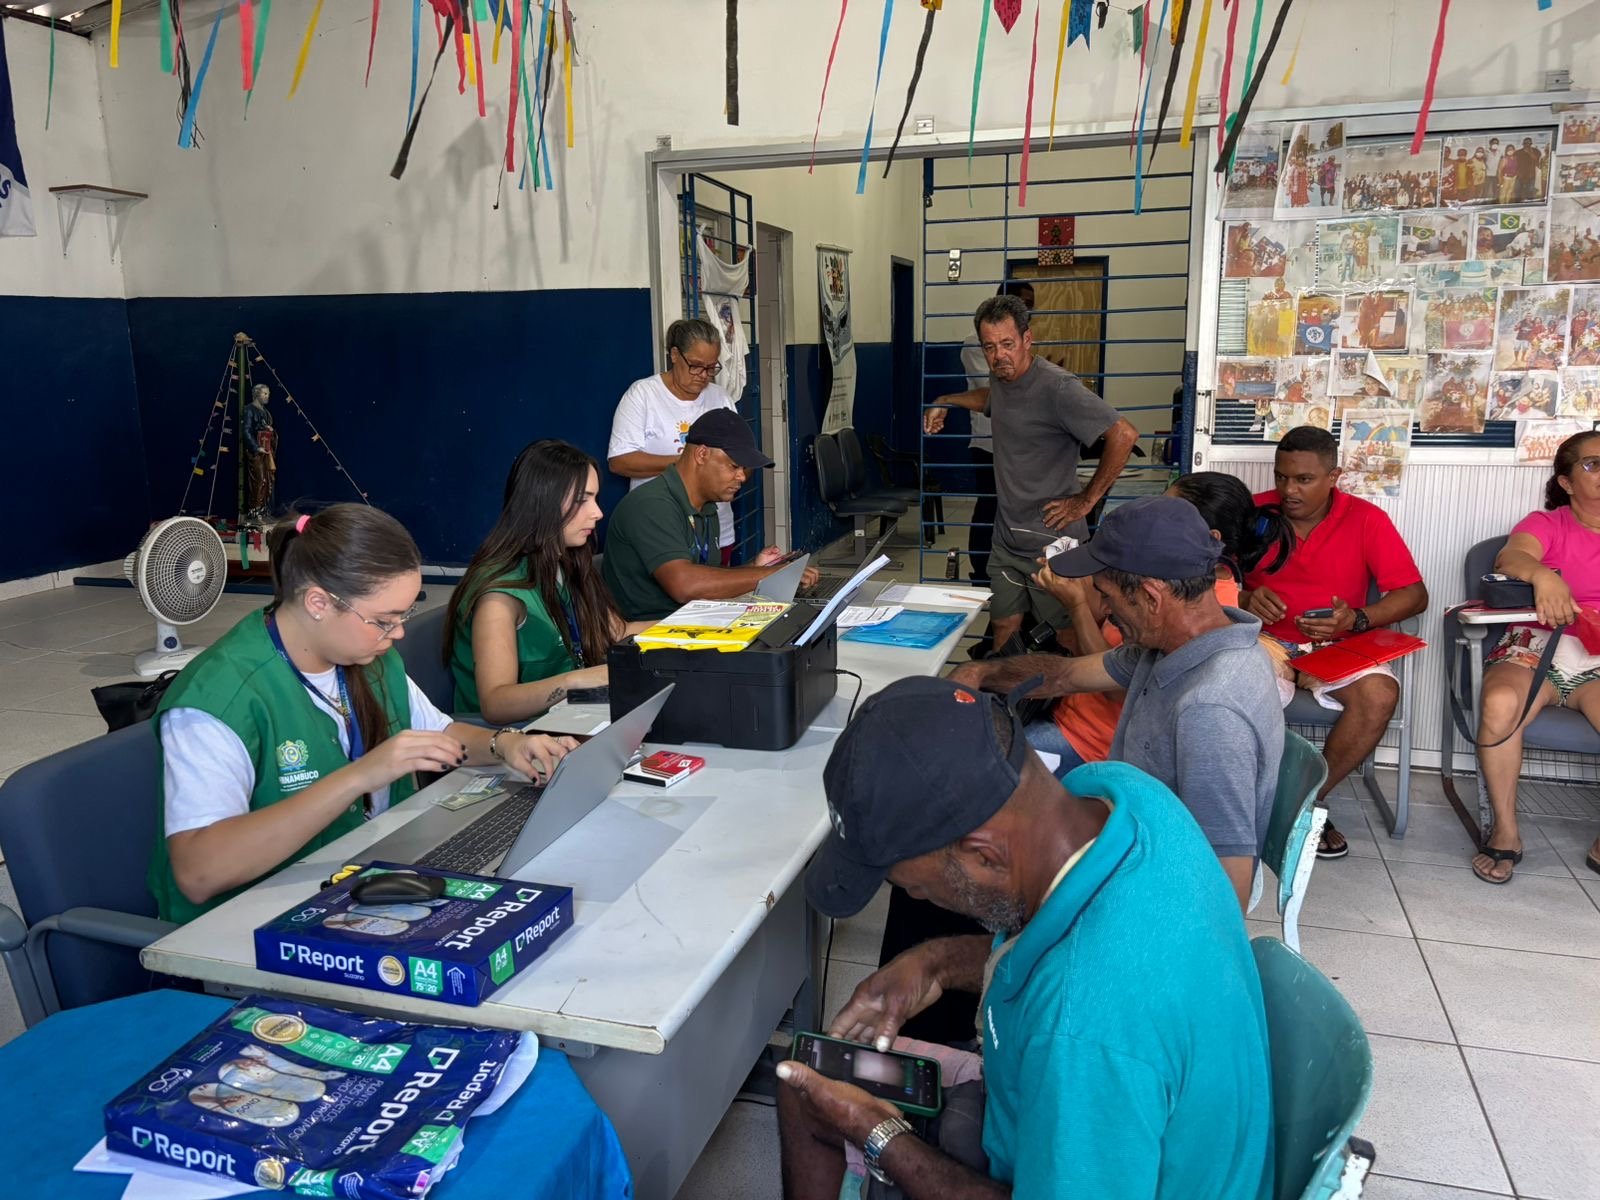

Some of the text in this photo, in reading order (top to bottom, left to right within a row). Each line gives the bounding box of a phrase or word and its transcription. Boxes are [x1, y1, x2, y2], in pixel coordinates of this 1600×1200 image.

[469, 884, 496, 899] A4
[444, 901, 527, 951] Report
[525, 906, 560, 944] Report
[297, 945, 364, 974] Report
[414, 960, 437, 979] A4
[371, 1044, 403, 1070] A4
[446, 1060, 497, 1109] Report
[345, 1072, 443, 1155] Report
[154, 1132, 236, 1176] Report
[333, 1126, 362, 1155] suzano
[294, 1170, 327, 1186] A4
